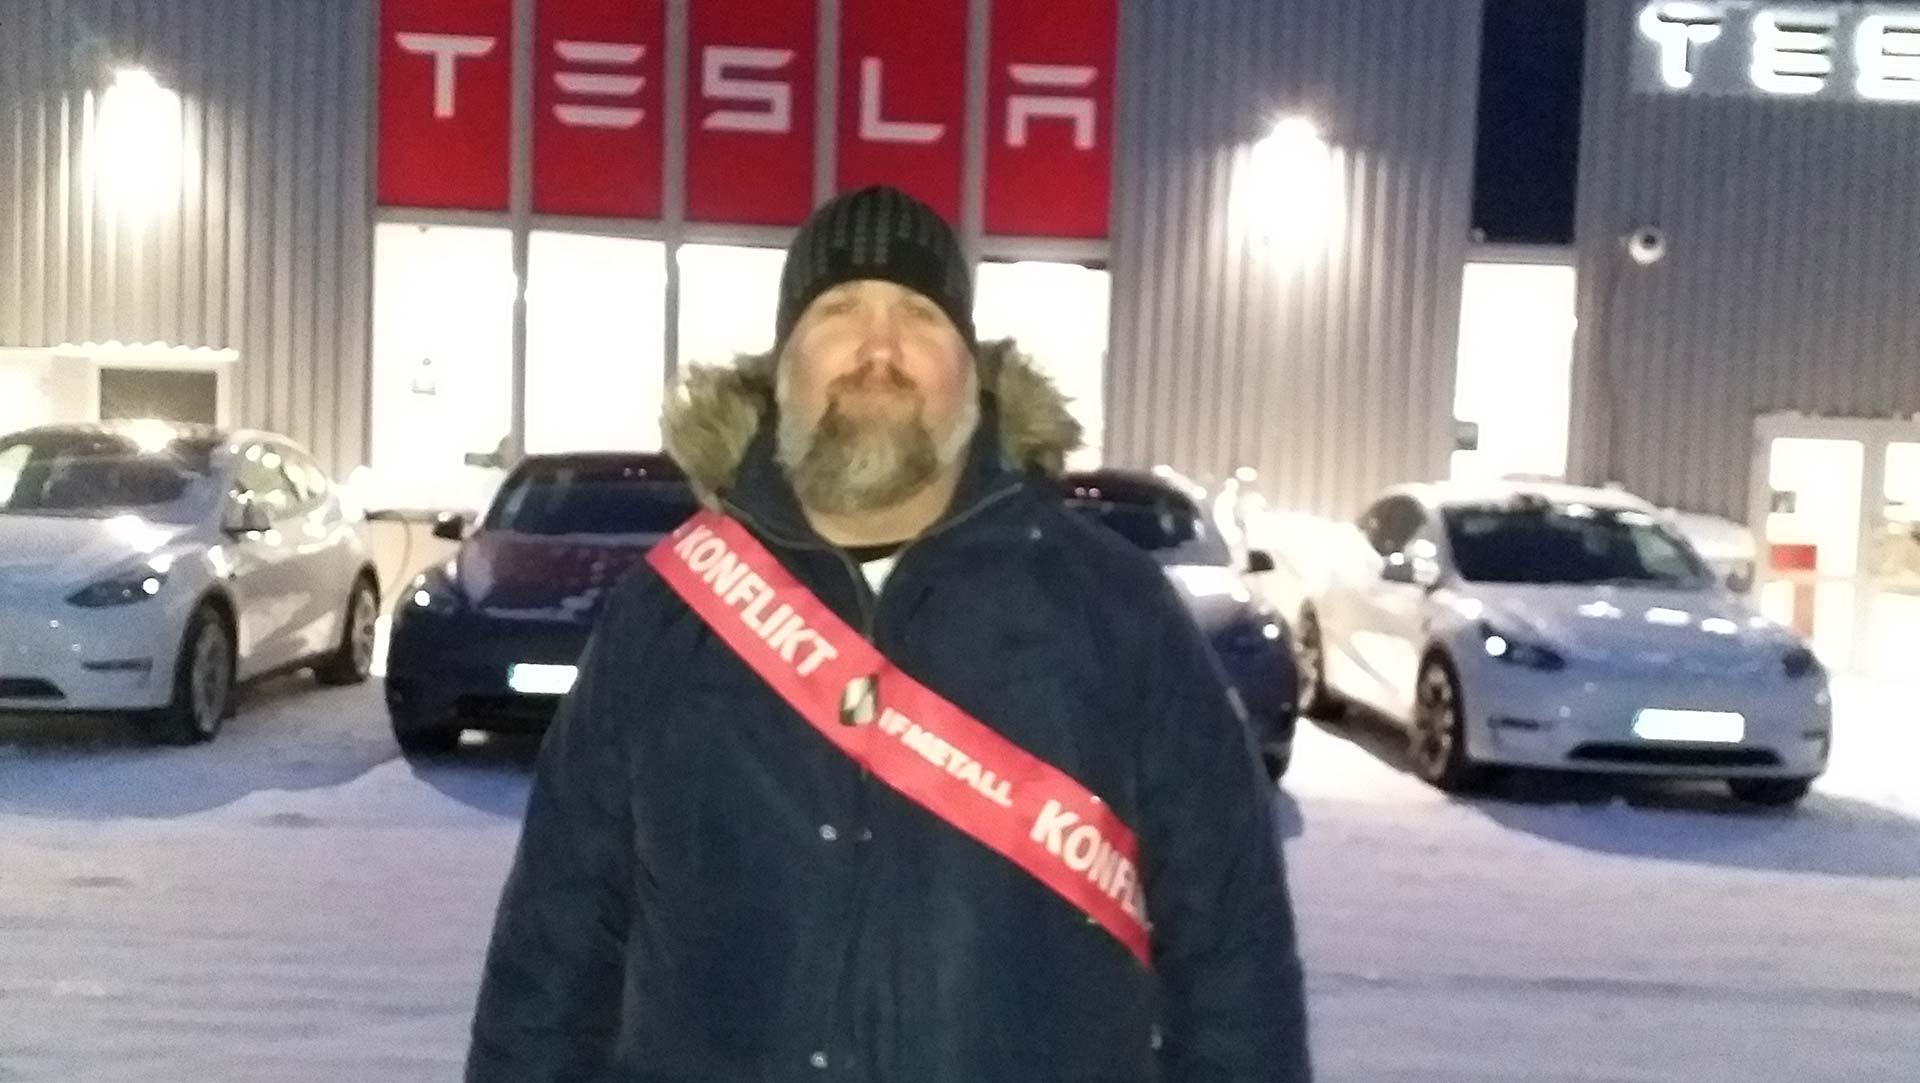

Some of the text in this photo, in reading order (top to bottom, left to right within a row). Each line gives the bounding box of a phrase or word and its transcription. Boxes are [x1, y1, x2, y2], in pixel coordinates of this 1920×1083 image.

[395, 33, 1097, 149] TESLA
[673, 524, 838, 677] KONFLIKT
[901, 723, 1013, 808] METALL
